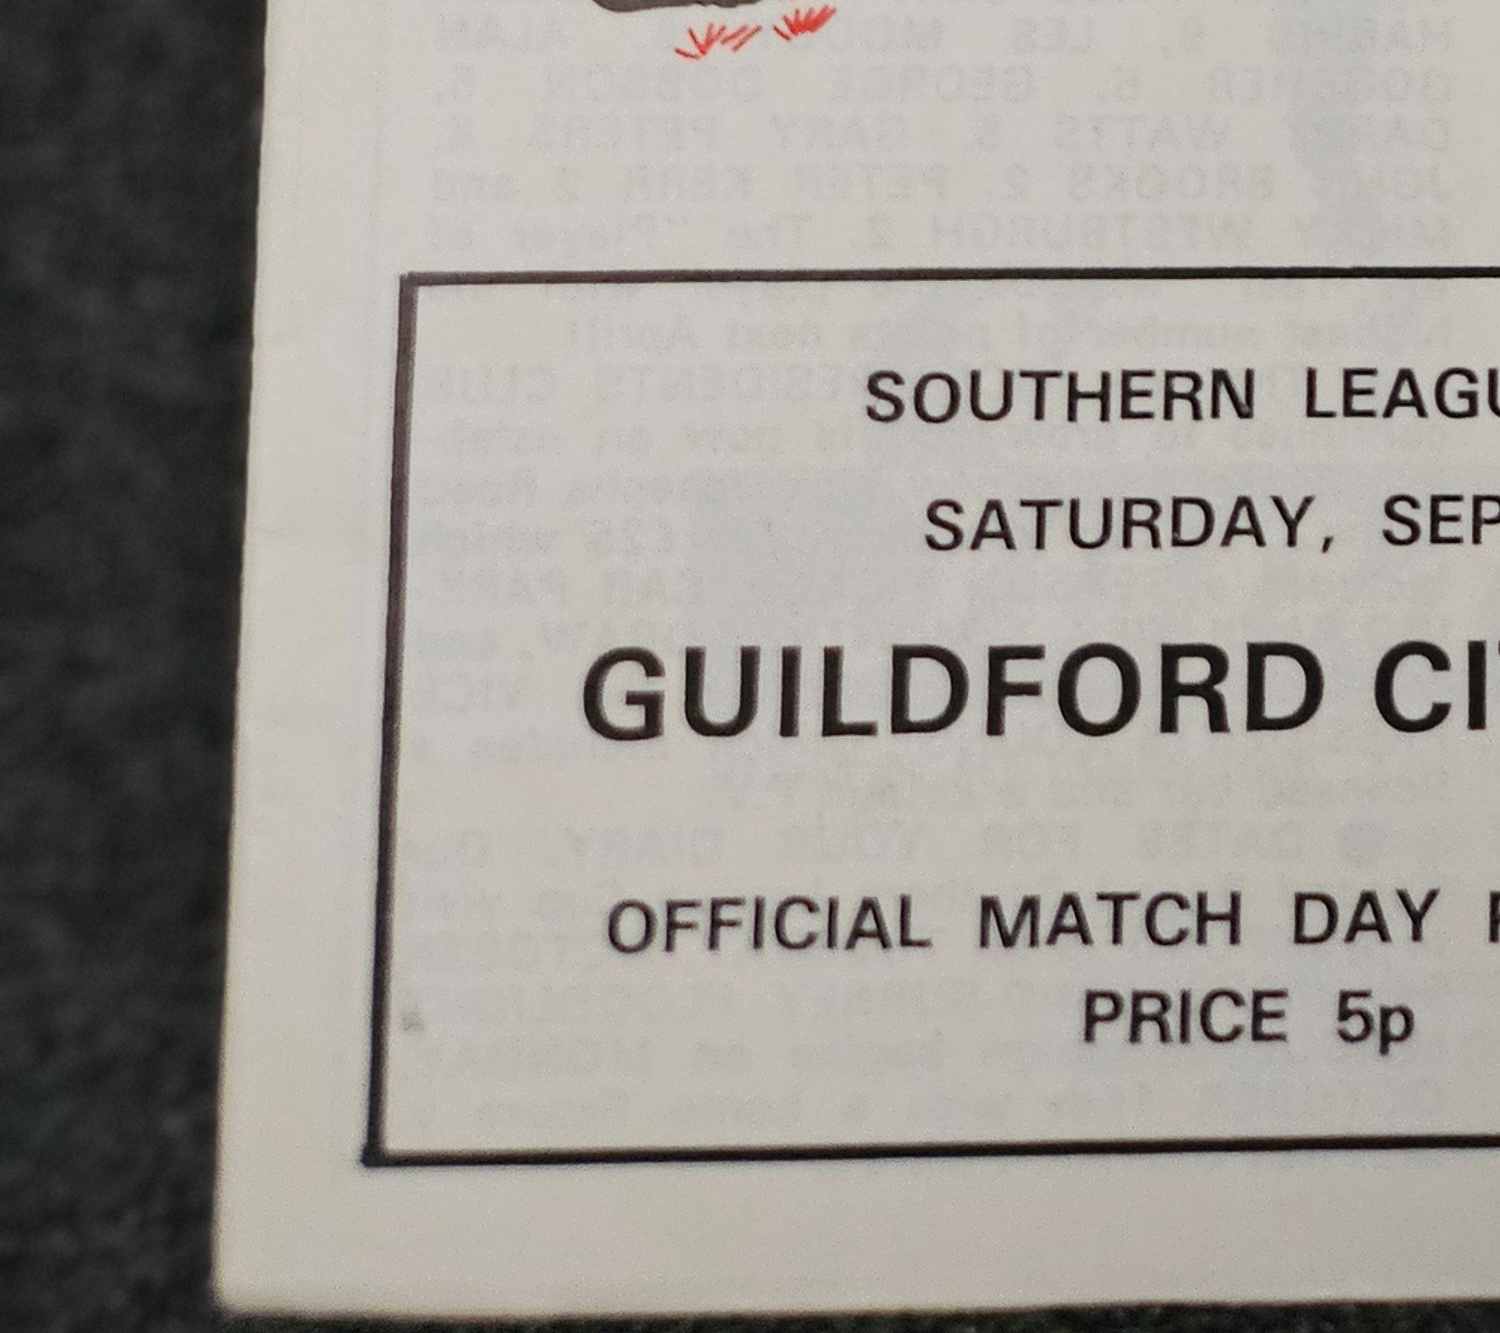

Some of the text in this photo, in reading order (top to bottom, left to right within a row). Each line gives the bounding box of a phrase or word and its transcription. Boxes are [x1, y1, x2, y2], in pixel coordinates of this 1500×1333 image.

[867, 368, 1254, 423] SOUTHERN
[926, 496, 1332, 553] SATURDAY,
[584, 642, 1324, 741] GUILDFORD
[608, 896, 930, 953] OFFICIAL
[980, 892, 1240, 948] MATCH
[1294, 889, 1439, 944] DAY
[1085, 989, 1414, 1055] PRICE 5p
